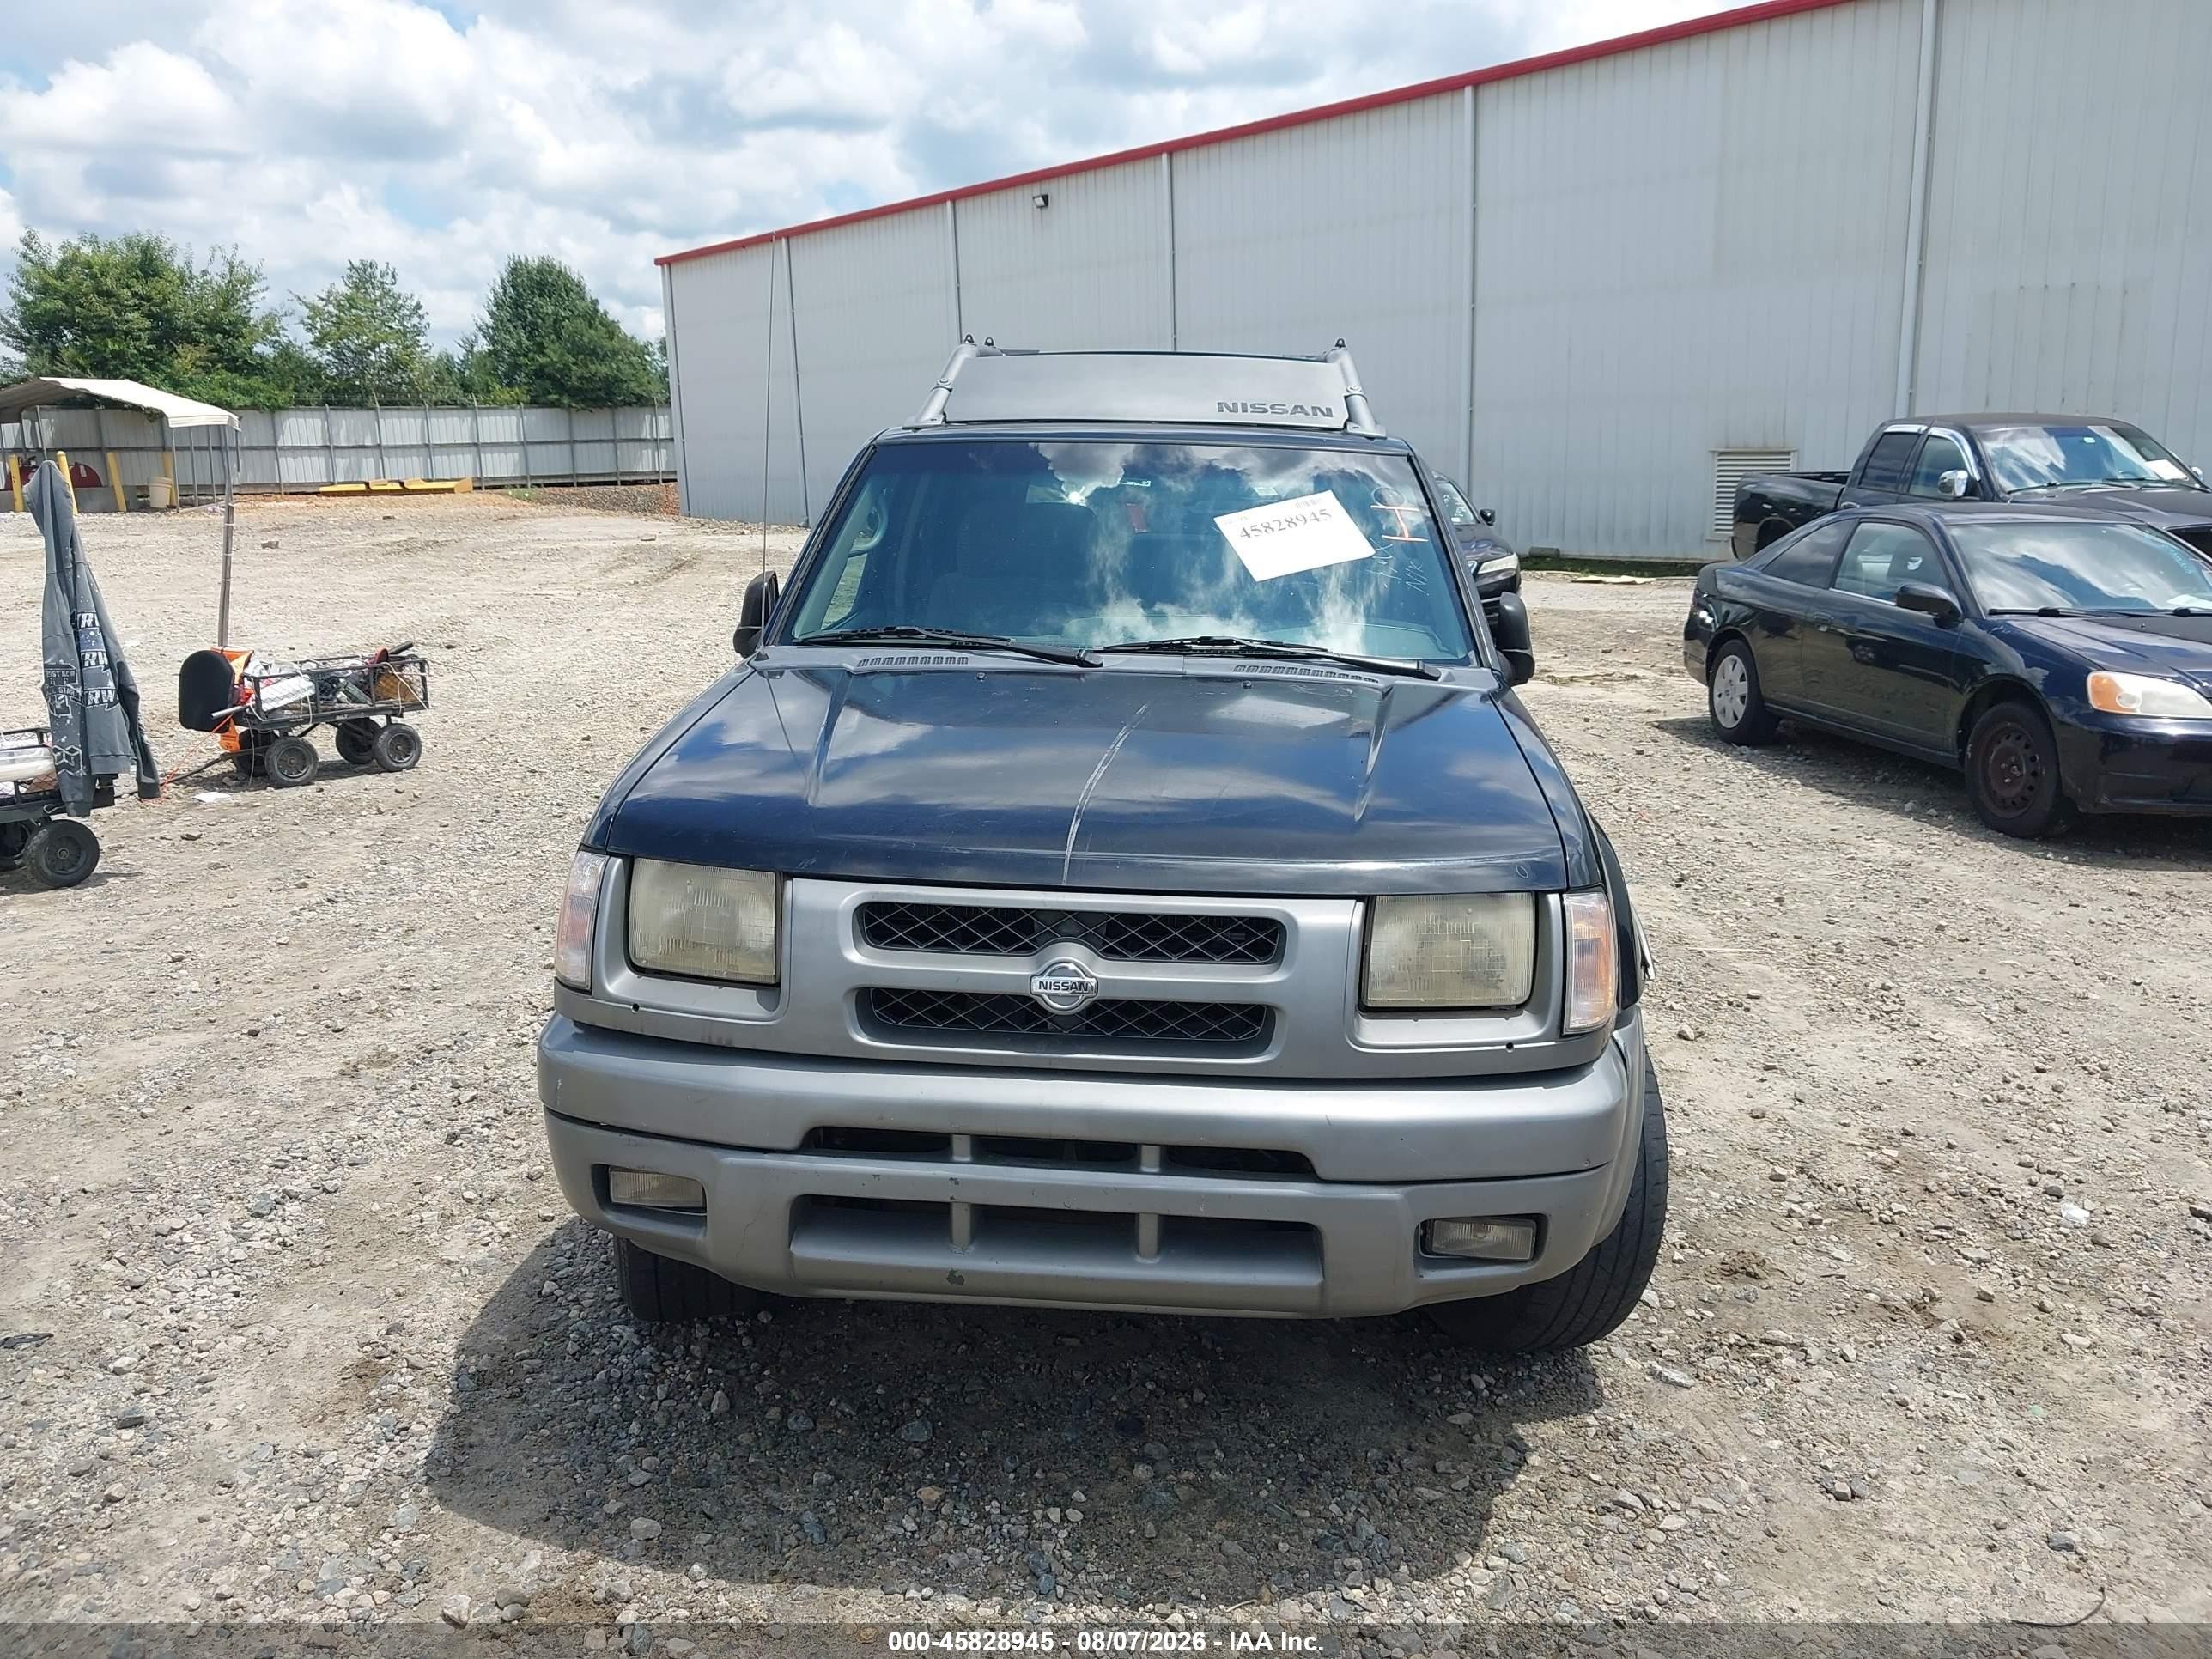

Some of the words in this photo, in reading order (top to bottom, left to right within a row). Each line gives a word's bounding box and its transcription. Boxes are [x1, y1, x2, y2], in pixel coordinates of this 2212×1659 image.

[1217, 401, 1334, 418] NISSAN
[1239, 508, 1333, 539] 45828945
[1038, 981, 1089, 992] NISSAN
